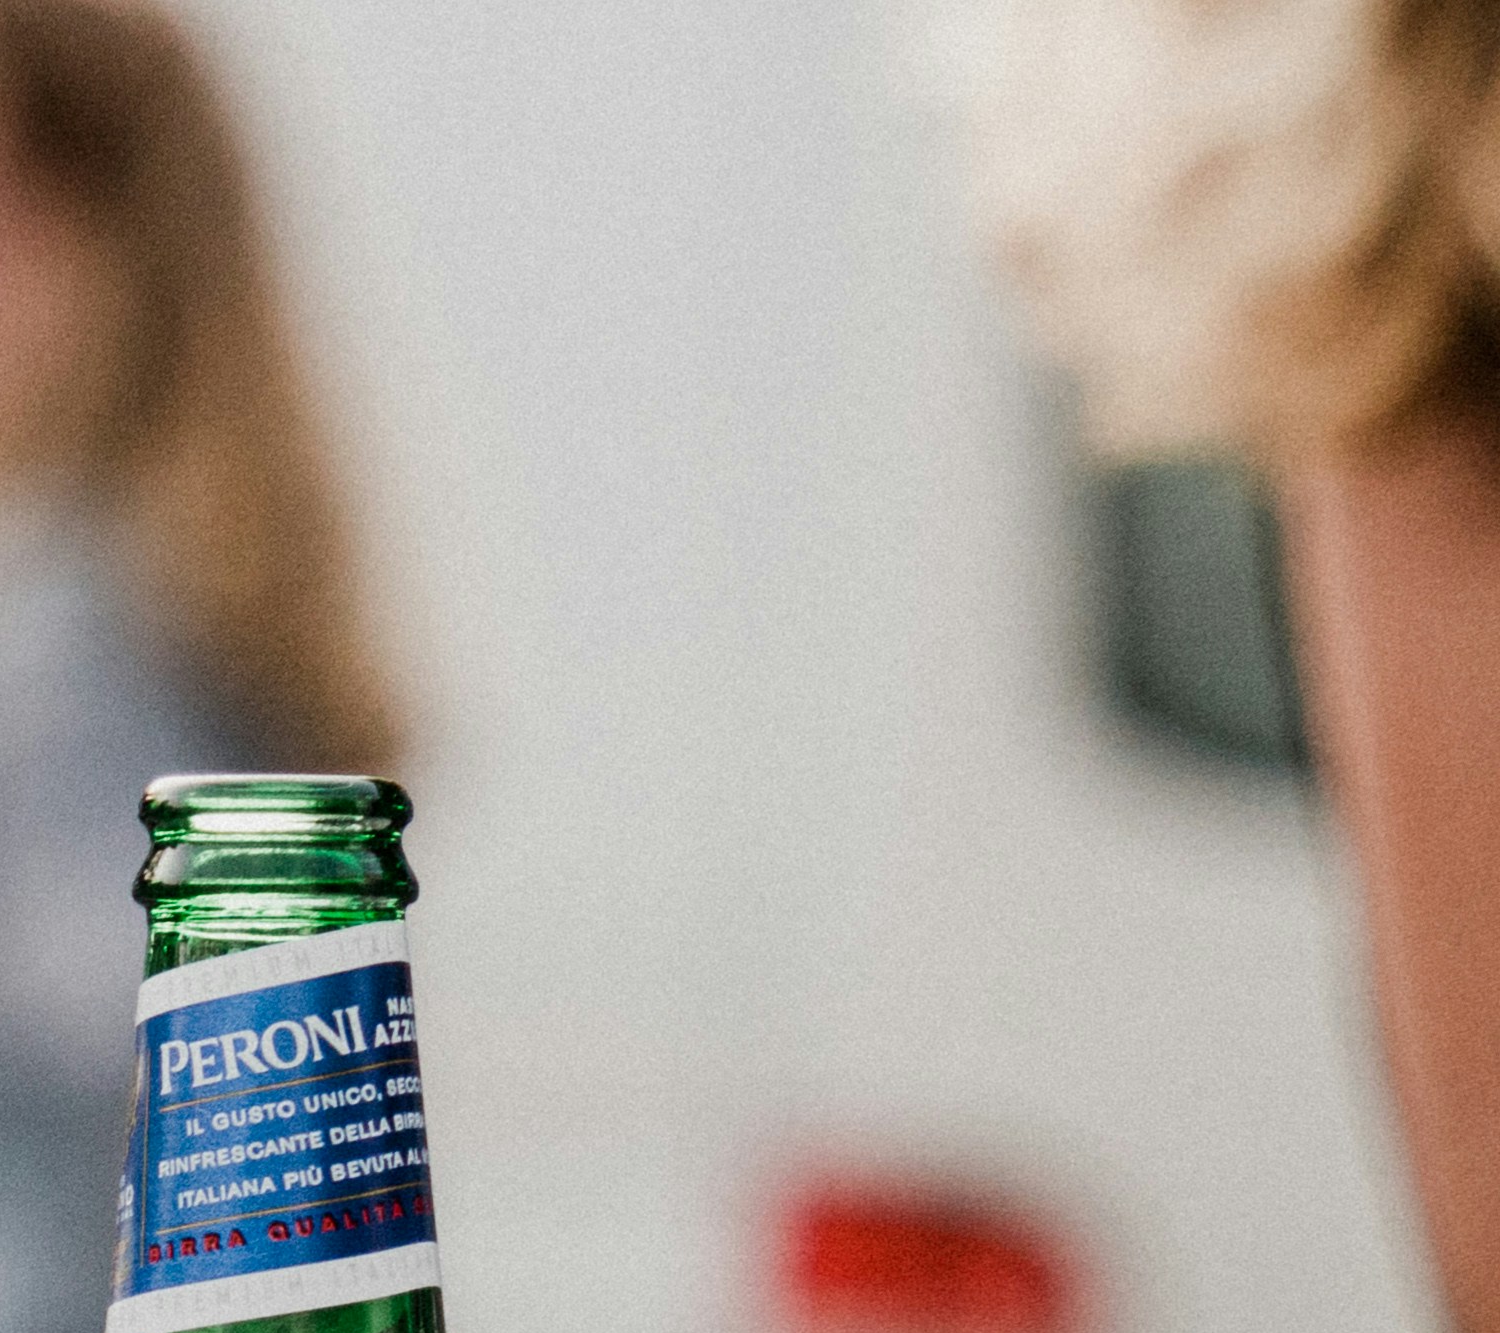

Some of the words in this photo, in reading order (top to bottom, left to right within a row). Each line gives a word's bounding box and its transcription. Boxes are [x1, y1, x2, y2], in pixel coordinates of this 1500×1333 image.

[159, 1004, 368, 1096] PERONI
[186, 1114, 204, 1137] IL
[214, 1099, 296, 1132] GUSTO
[303, 1083, 383, 1116] UNICO,
[158, 1129, 324, 1179] RINFRESCANTE
[330, 1118, 392, 1145] DELLA
[177, 1176, 276, 1210] ITALIANA
[284, 1162, 324, 1190] PIÙ
[331, 1151, 404, 1183] BEVUTA
[148, 1228, 247, 1265] BIRRA
